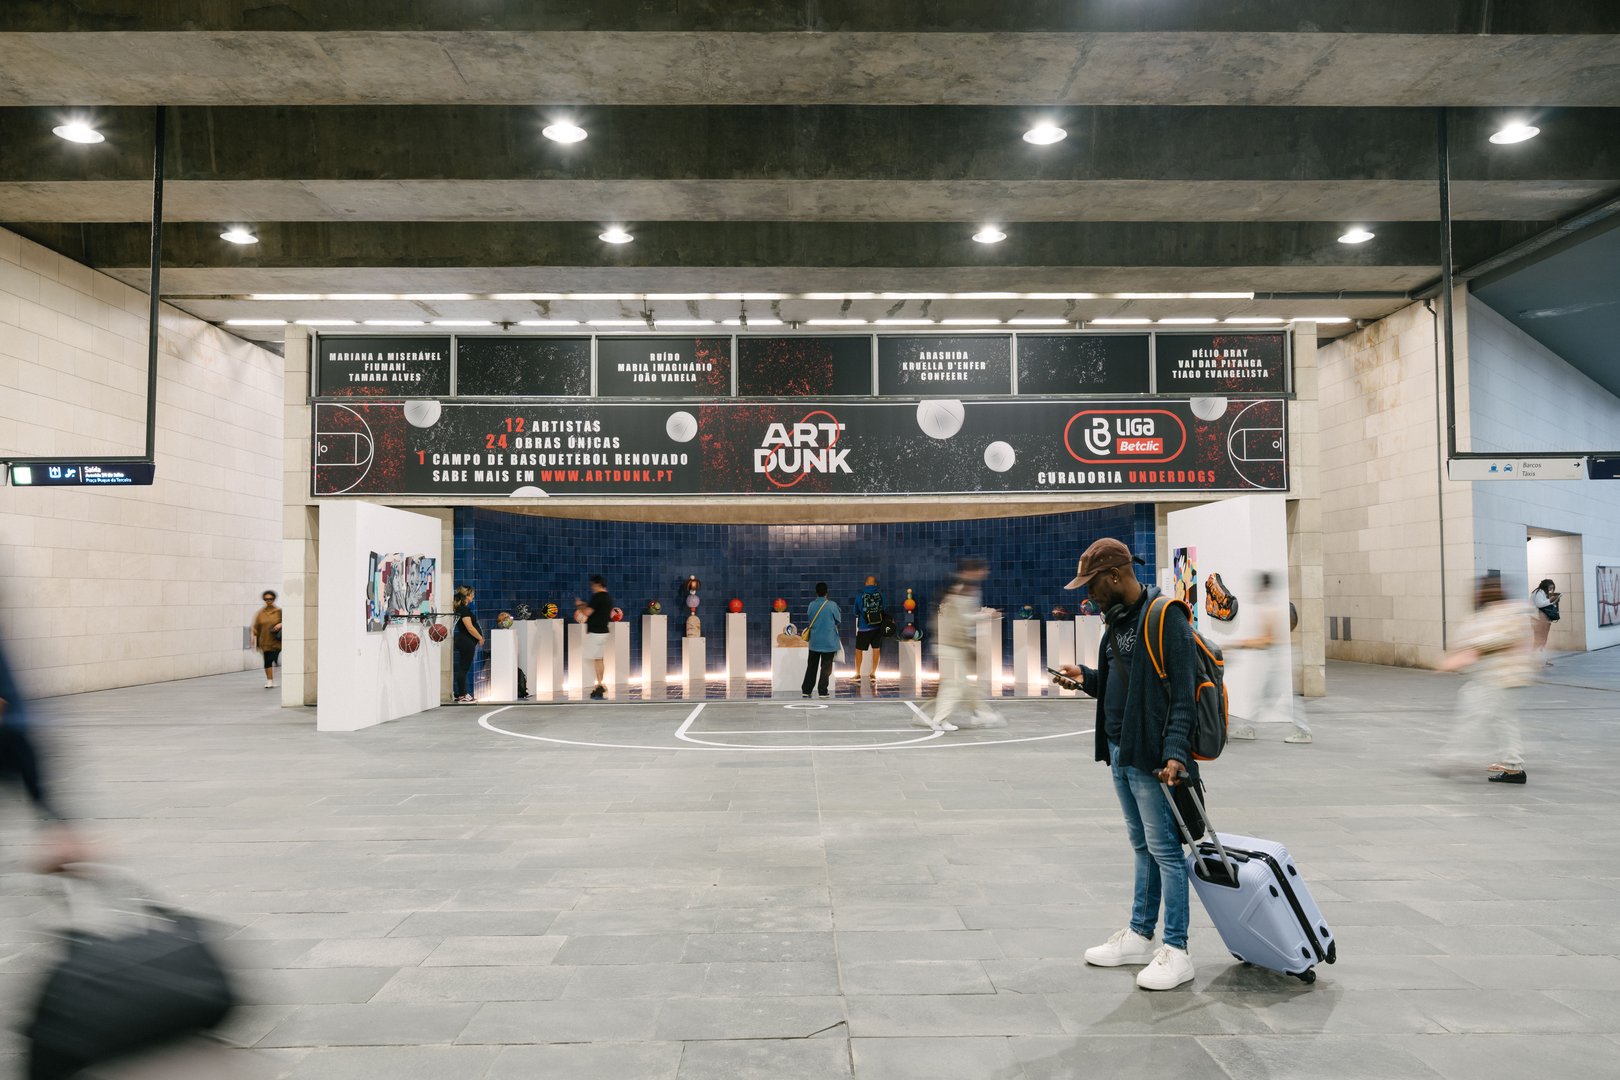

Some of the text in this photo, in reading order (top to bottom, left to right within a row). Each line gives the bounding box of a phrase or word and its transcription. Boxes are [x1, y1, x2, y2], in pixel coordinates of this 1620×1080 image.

[329, 350, 442, 362] MARIANA A MISERÁVEL
[650, 352, 680, 362] RUÍDO
[920, 351, 969, 360] ARASHIDA
[1192, 348, 1248, 358] HÉLIO BRAY
[364, 362, 406, 372] FIUMANI
[618, 362, 712, 372] MARIA IMAGINÁRIO
[902, 361, 986, 370] KRUELLA D'ENFER
[1178, 359, 1263, 368] VAI DAR PITANGA
[349, 373, 422, 382] TAMARA ALVES
[633, 372, 697, 382] JOÃO VARELA
[920, 372, 968, 380] CONFEERE
[1172, 370, 1269, 379] TIAGO EVANGELISTA
[505, 417, 601, 433] 12 ARTISTAS
[761, 423, 846, 448] ART
[486, 434, 620, 449] 24 OBRAS ÚNICAS
[1120, 440, 1160, 453] Betclic
[417, 450, 689, 467] 1 CAMPO DE BASQUETEBOL RENOVADO
[753, 449, 853, 474] DUNK
[432, 470, 674, 482] SABE MAIS EM WWW.ARTDUNK.PT
[1038, 470, 1216, 485] CURADORIA UNDERDOGS
